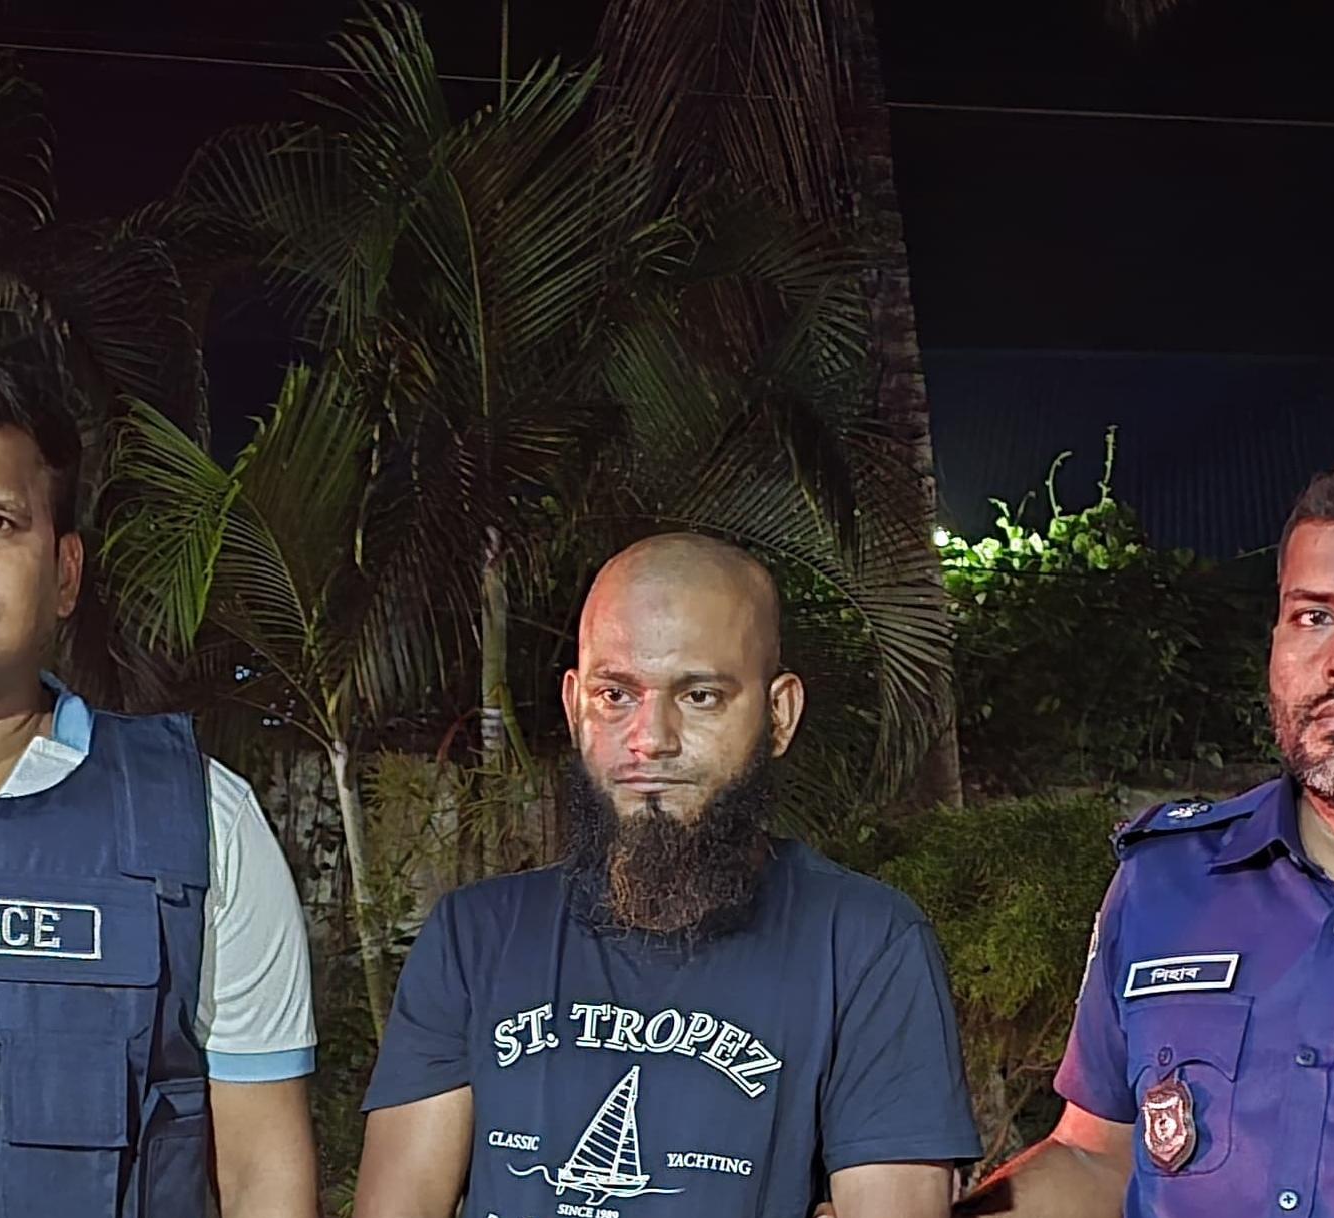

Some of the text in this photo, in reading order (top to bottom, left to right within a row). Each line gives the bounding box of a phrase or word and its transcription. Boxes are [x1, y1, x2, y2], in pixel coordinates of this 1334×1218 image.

[494, 1003, 783, 1098] ST. TROPEZ
[488, 1131, 541, 1151] CLASSIC
[666, 1152, 753, 1176] YACHTING
